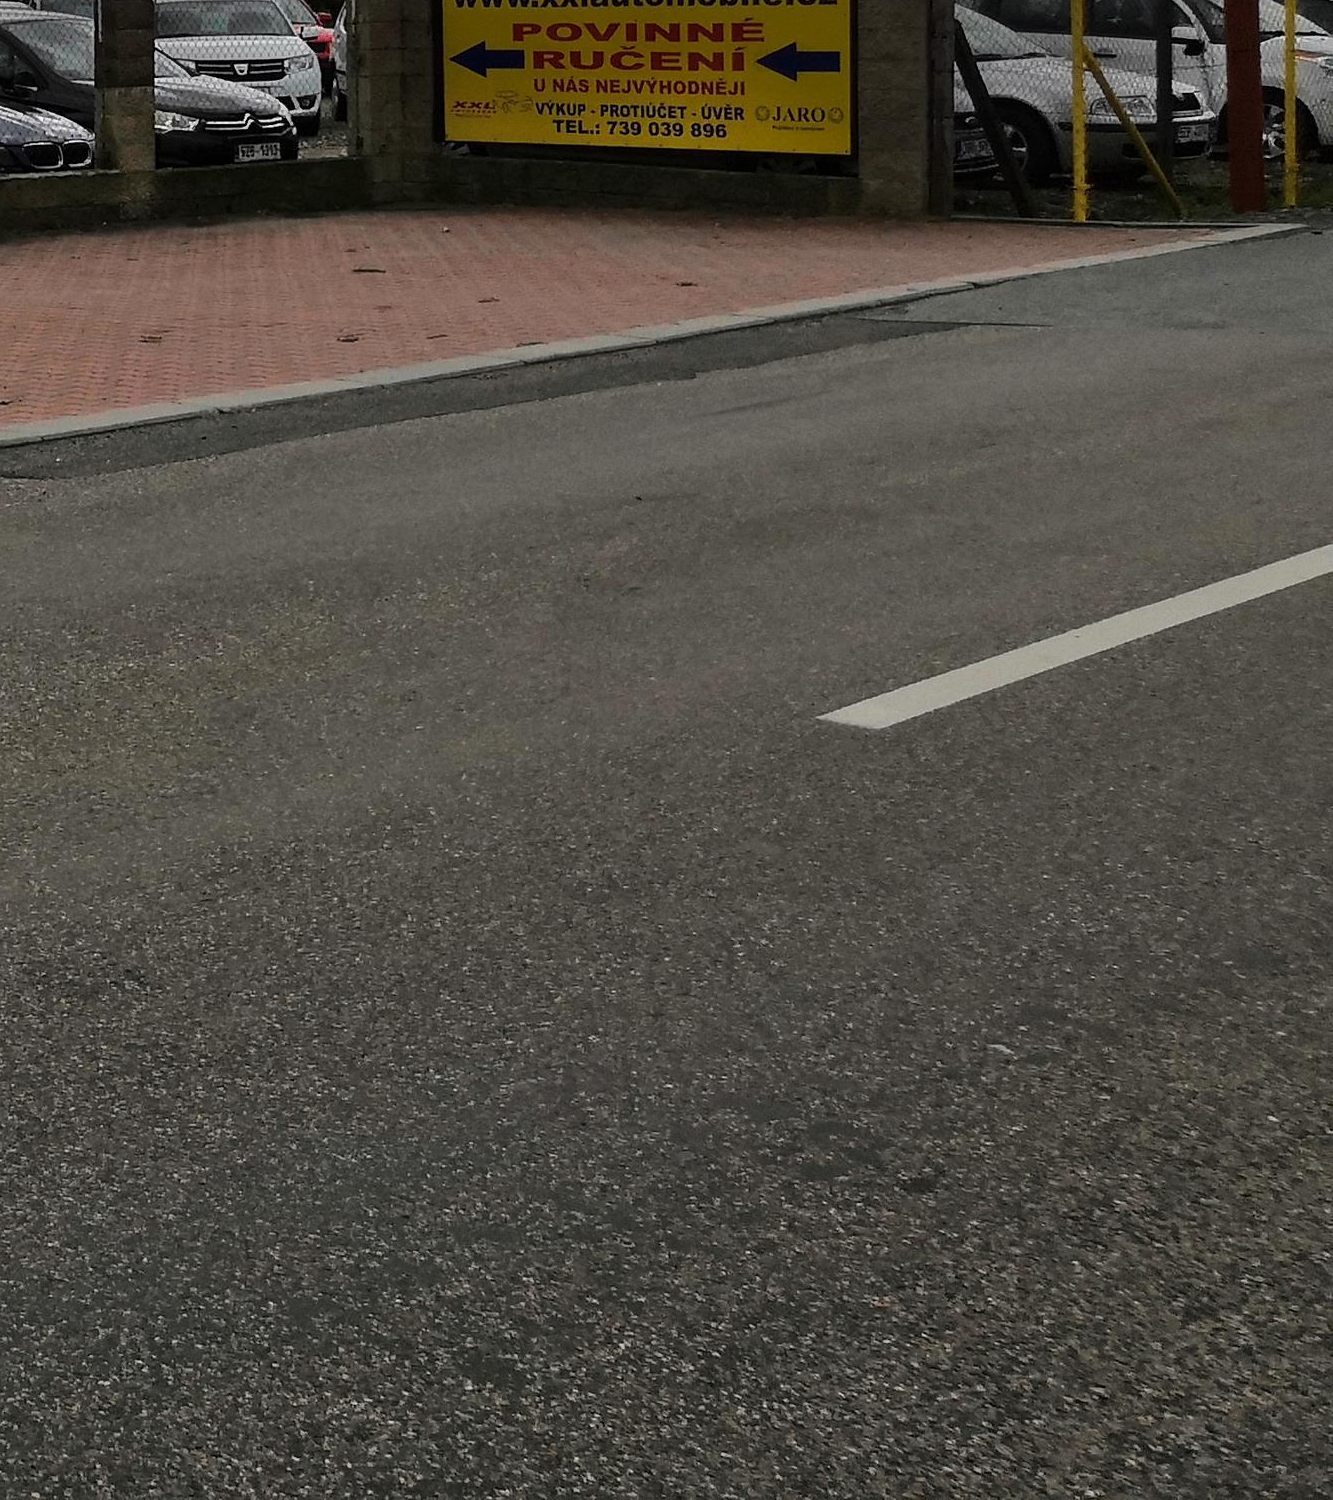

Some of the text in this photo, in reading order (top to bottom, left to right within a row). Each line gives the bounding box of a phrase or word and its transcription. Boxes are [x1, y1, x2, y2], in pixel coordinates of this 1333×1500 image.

[512, 17, 764, 43] POVINNÉ
[532, 45, 745, 71] RUČENÍ
[533, 76, 746, 96] U NÁS NEJVÝHODNĚJI
[535, 100, 587, 117] VÝKUP
[599, 102, 687, 120] PROTIÚČET
[700, 104, 746, 121] ÚVĚR
[772, 106, 826, 123] JARO
[552, 119, 728, 138] TEL.: 739 039 896
